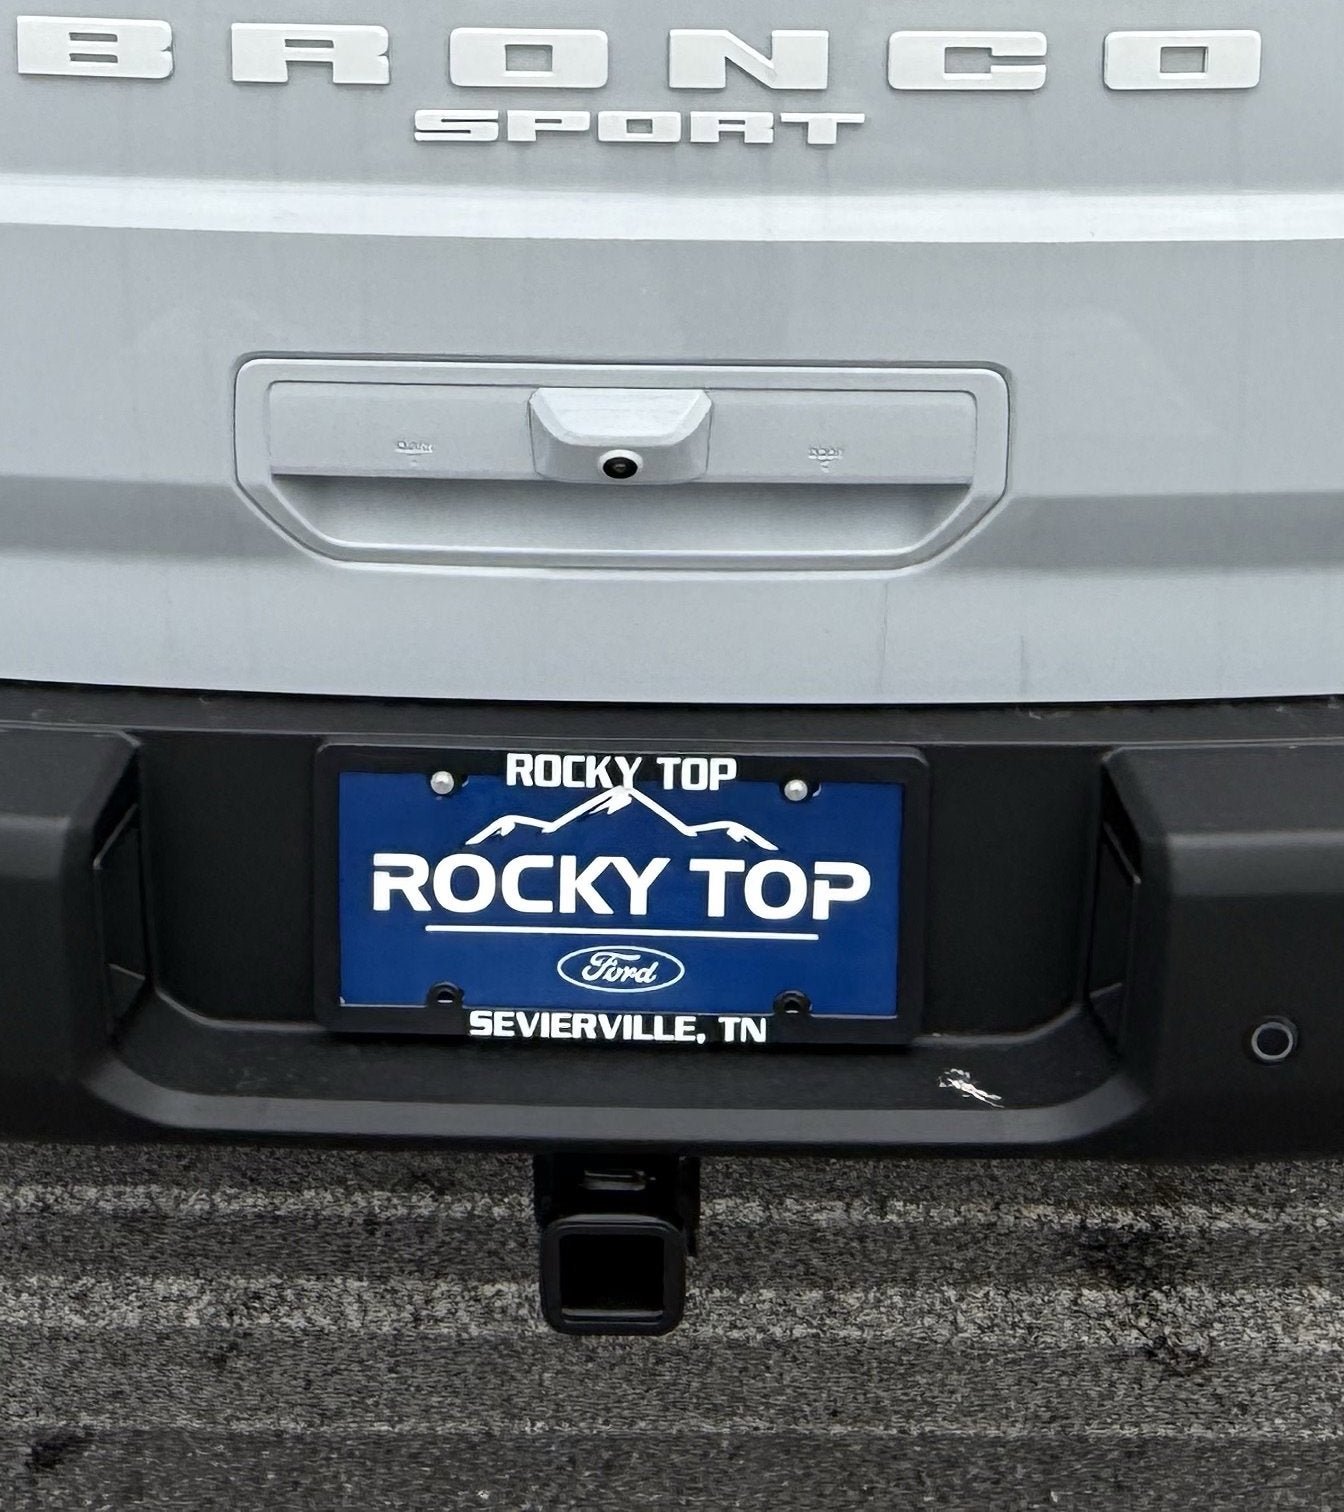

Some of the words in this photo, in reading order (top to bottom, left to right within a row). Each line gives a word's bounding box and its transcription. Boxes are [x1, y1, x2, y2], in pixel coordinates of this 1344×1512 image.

[16, 14, 1262, 91] BRONCO
[413, 108, 866, 145] SPORT
[506, 752, 644, 789] ROCKY
[656, 756, 738, 792] TOP
[372, 852, 672, 917] ROCKY
[688, 858, 872, 921] TOP
[581, 951, 659, 985] Ford
[468, 1009, 707, 1045] SEVIERVILLE,
[718, 1016, 767, 1044] TN
